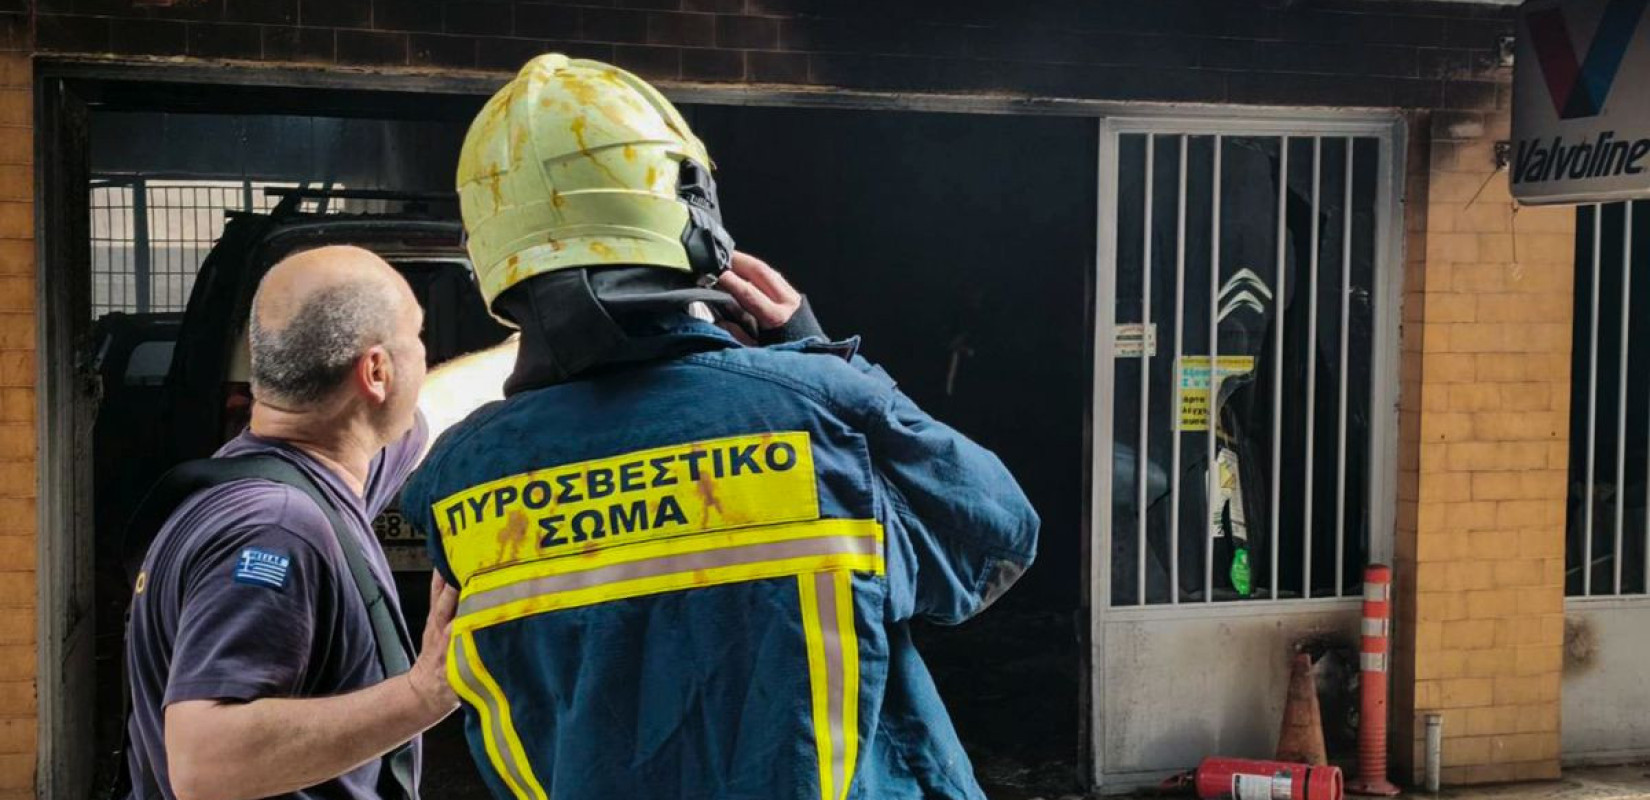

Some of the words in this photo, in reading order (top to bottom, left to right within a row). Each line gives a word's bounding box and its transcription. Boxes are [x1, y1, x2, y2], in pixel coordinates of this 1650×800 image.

[1513, 131, 1650, 184] Valvoline
[446, 441, 797, 536] ΠΥΡΟΣΒΕΣΤΙΚΟ
[538, 494, 689, 549] ΣΩΜΑ
